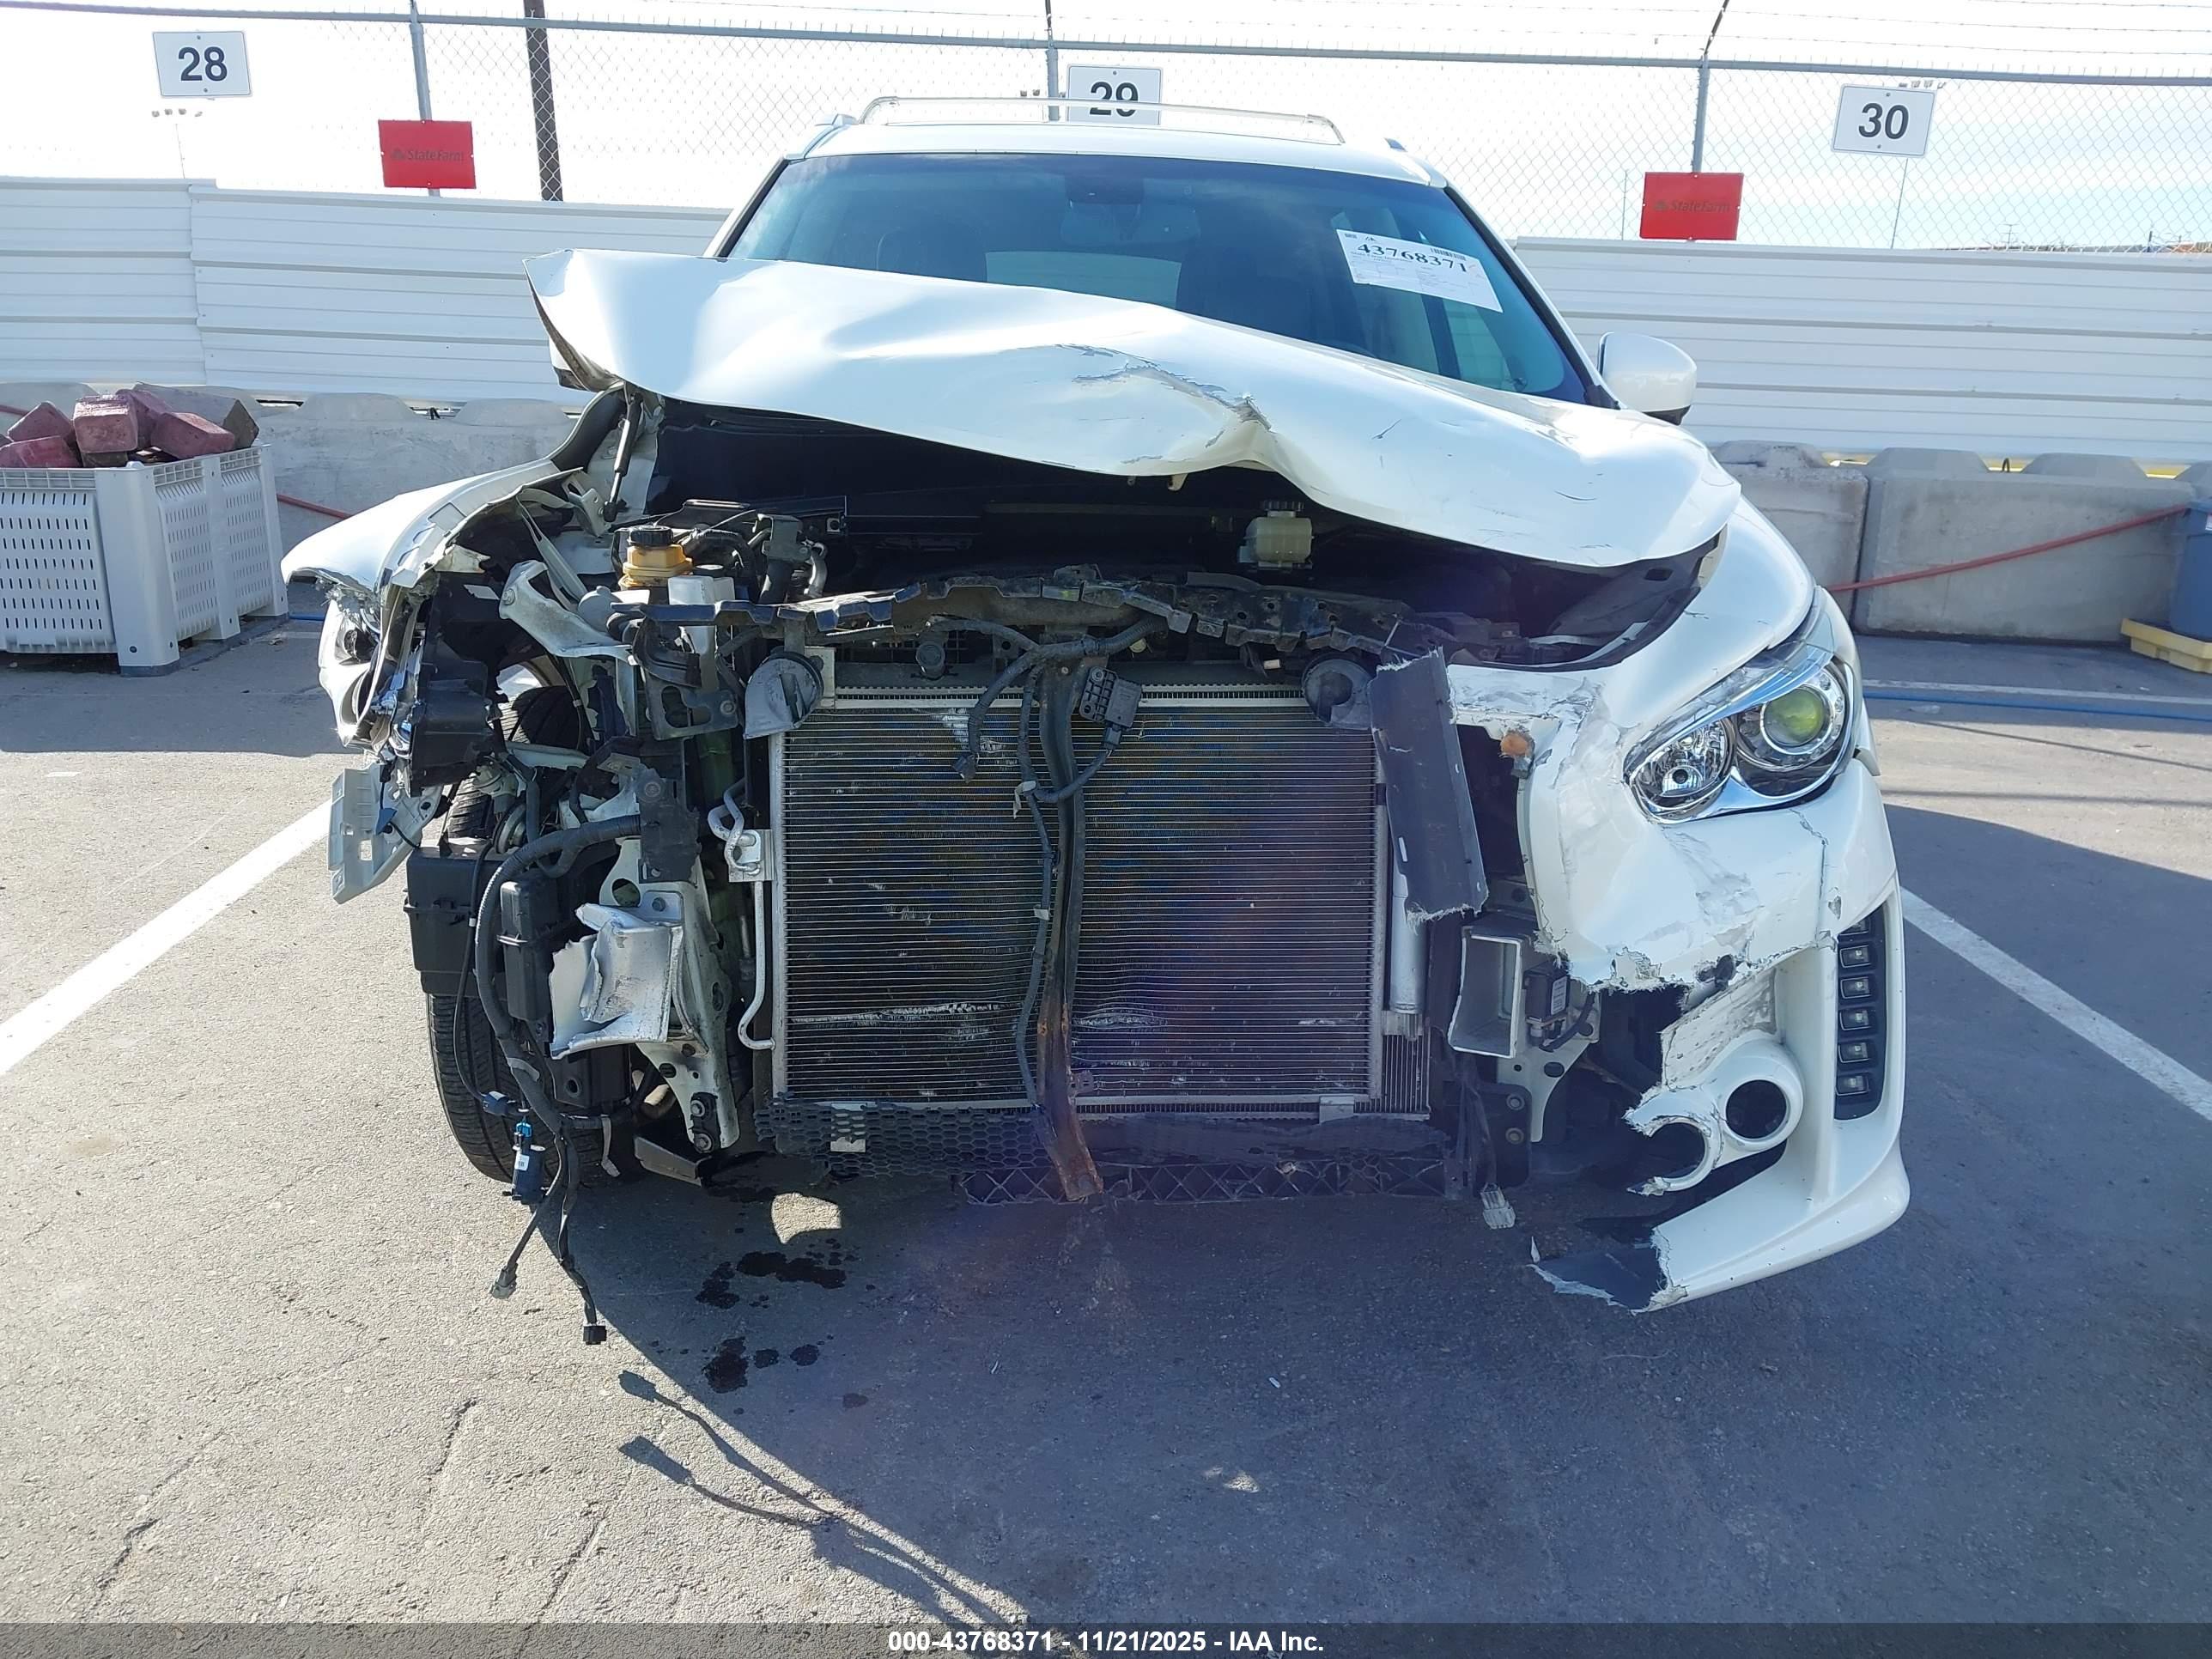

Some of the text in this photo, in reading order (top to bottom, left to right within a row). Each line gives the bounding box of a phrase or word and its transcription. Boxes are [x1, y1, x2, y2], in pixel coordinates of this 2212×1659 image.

[178, 46, 228, 82] 28
[1089, 81, 1139, 118] 29
[1858, 102, 1909, 140] 30
[1357, 243, 1468, 273] 43768371
